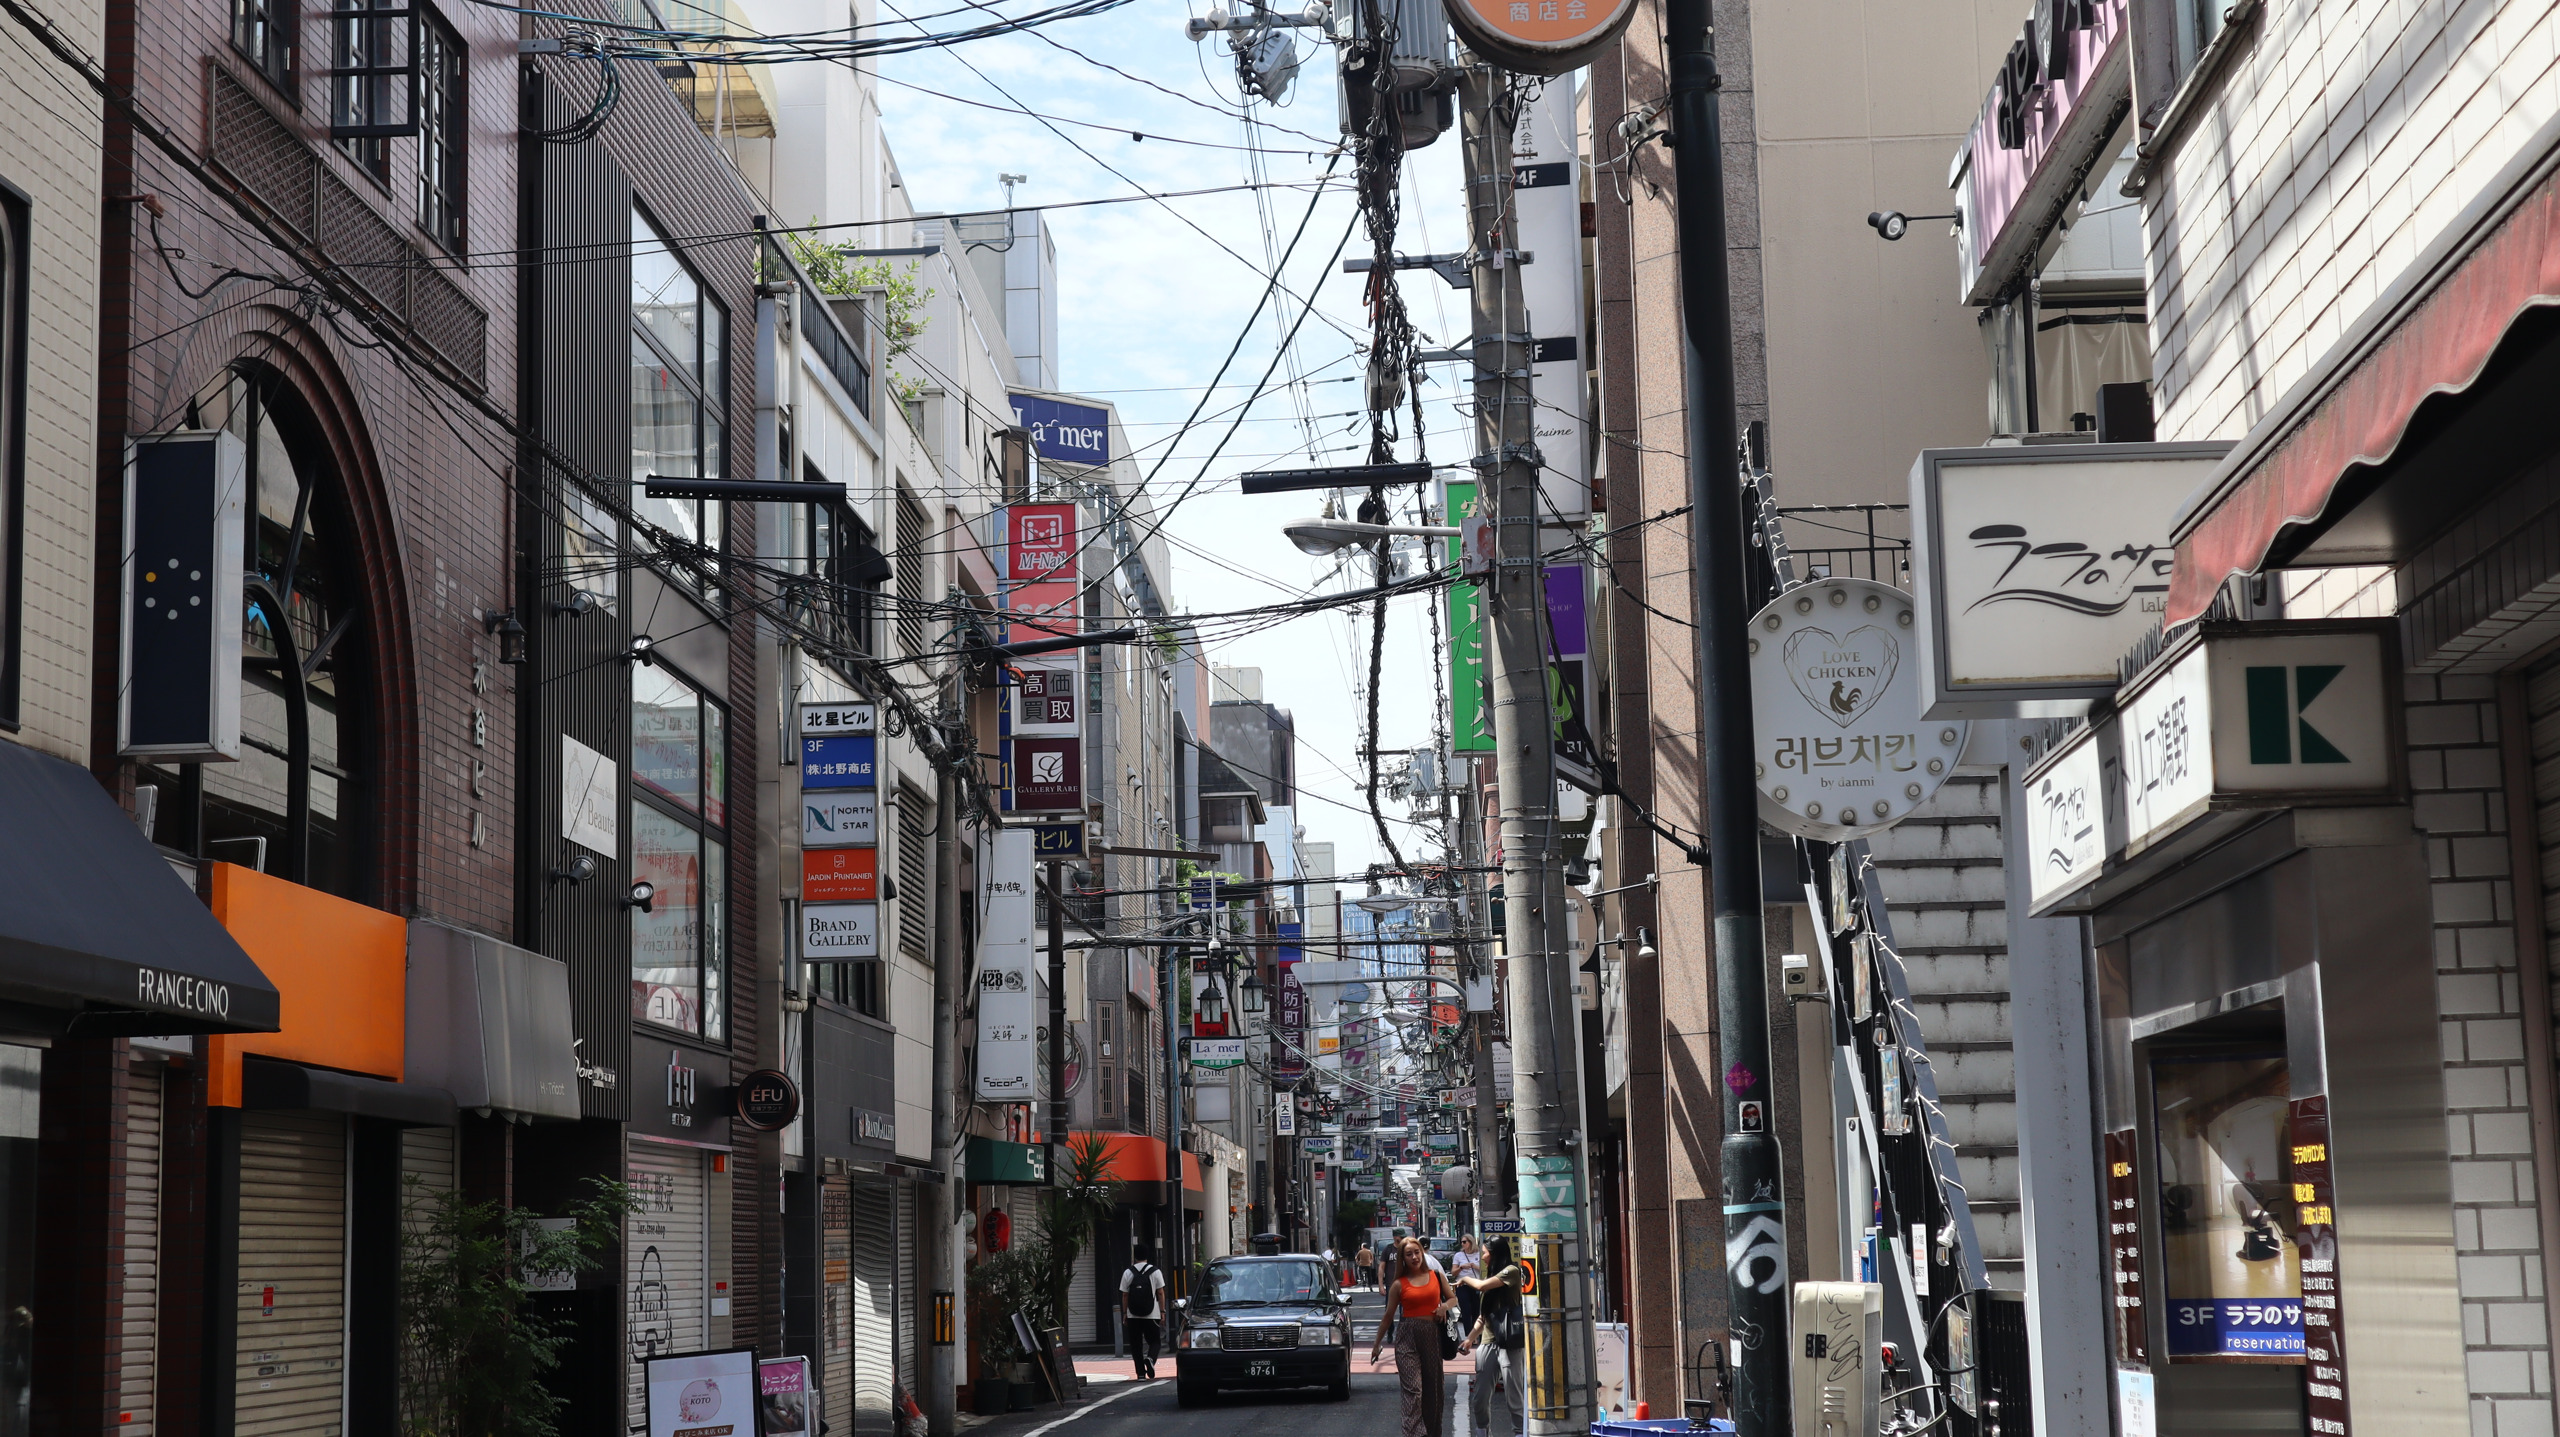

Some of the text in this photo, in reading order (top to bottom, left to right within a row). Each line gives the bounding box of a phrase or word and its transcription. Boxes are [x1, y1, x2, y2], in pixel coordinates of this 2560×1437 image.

[1509, 0, 1587, 22] 商店会
[1822, 651, 1861, 665] LOVE
[1808, 666, 1877, 680] CHICKEN
[999, 686, 1010, 713] 2
[807, 711, 869, 726] 北星ビル
[807, 740, 824, 752] 3F
[1774, 733, 1918, 775] 러브치킨
[1001, 762, 1011, 790] 1
[1821, 776, 1875, 791] by danmi
[1018, 784, 1079, 794] GALLERY RARE
[587, 798, 615, 837] Beaute
[838, 807, 873, 815] NORTH
[842, 821, 869, 830] STAR
[807, 871, 873, 881] JARDIN PRINTANIER
[809, 917, 857, 932] BRAND
[808, 932, 872, 947] GALLERY
[980, 972, 1004, 987] 428
[138, 967, 229, 1022] FRANCE CINQ
[1283, 972, 1300, 1063] 周防町会館
[751, 1084, 784, 1103] ÉFU
[1307, 1139, 1332, 1147] NIPPO
[2113, 1162, 2129, 1178] MENU
[2179, 1304, 2302, 1326] 3F ララのサ
[1250, 1365, 1275, 1376] 87-61
[690, 1397, 711, 1406] KOTO
